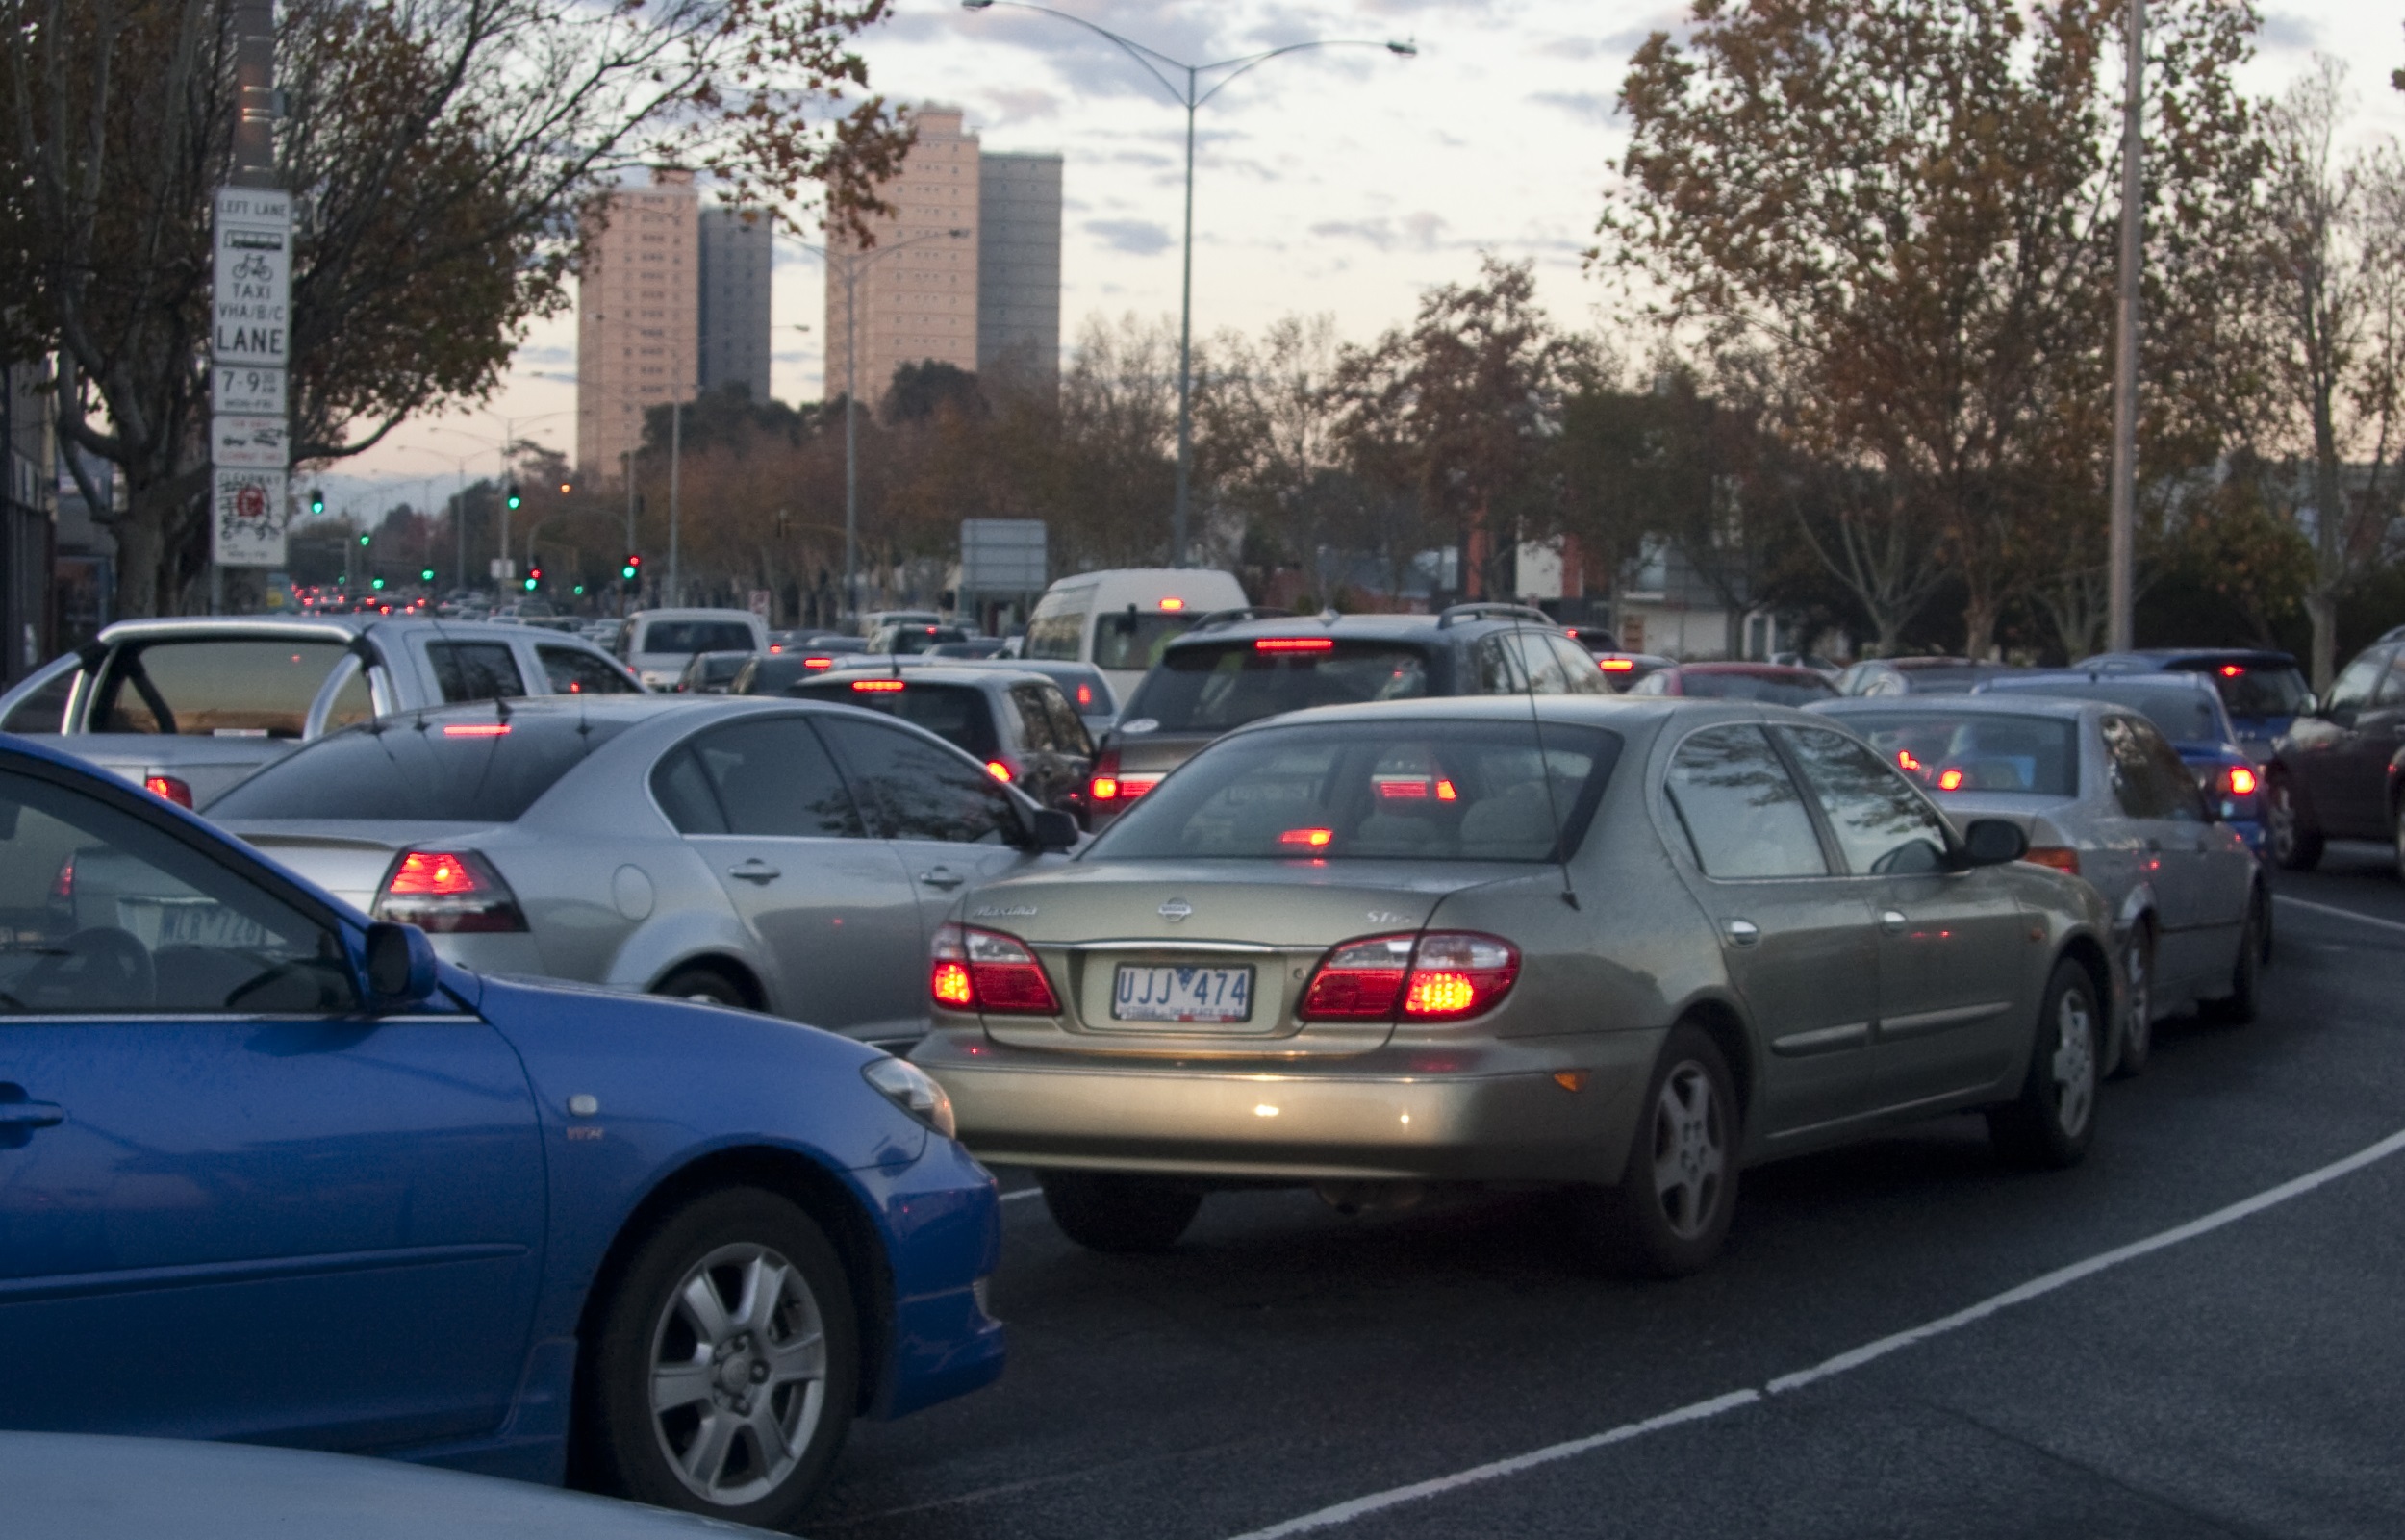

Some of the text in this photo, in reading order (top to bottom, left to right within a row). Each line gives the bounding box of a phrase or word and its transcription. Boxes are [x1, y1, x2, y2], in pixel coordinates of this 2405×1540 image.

[219, 199, 287, 216] LEFT LANE
[233, 283, 271, 300] TAXI
[217, 325, 284, 355] LANE
[1118, 971, 1246, 1006] UJJ 474
